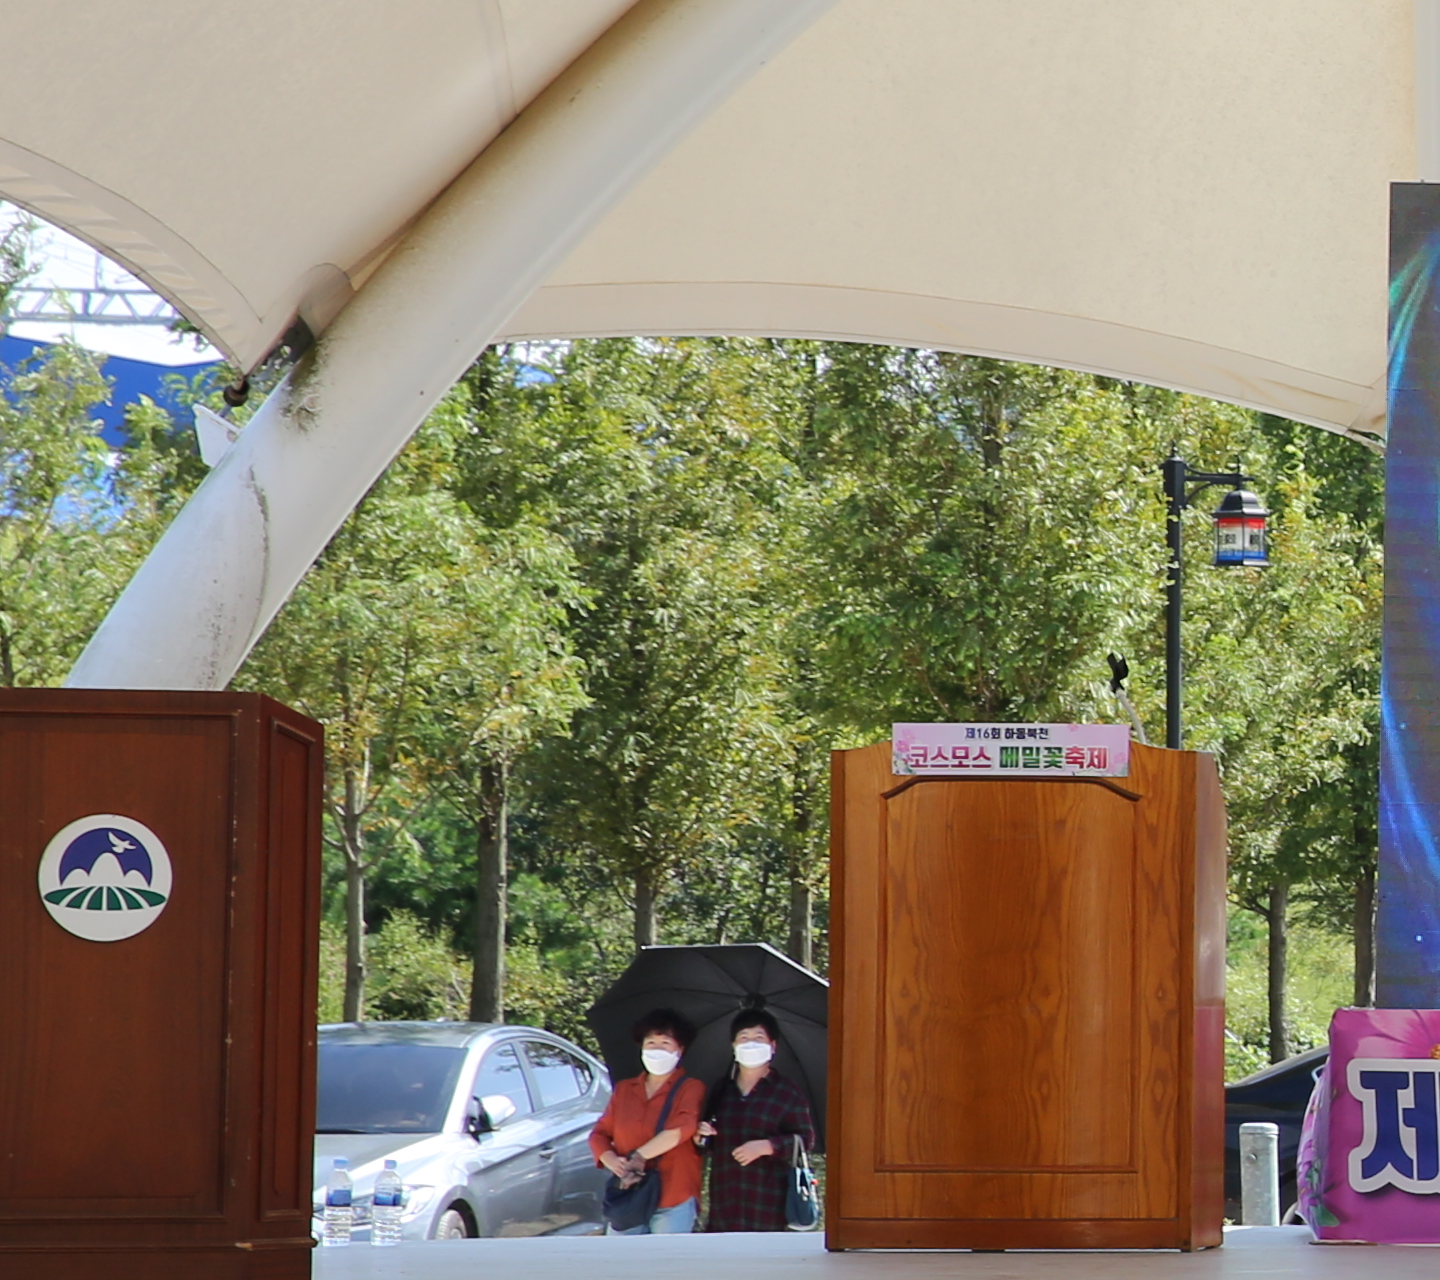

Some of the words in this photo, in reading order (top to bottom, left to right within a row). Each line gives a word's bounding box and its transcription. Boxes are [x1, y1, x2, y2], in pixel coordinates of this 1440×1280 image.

[964, 727, 1001, 740] 제16회
[1004, 727, 1049, 740] 하동북천
[909, 745, 993, 769] 코스모스
